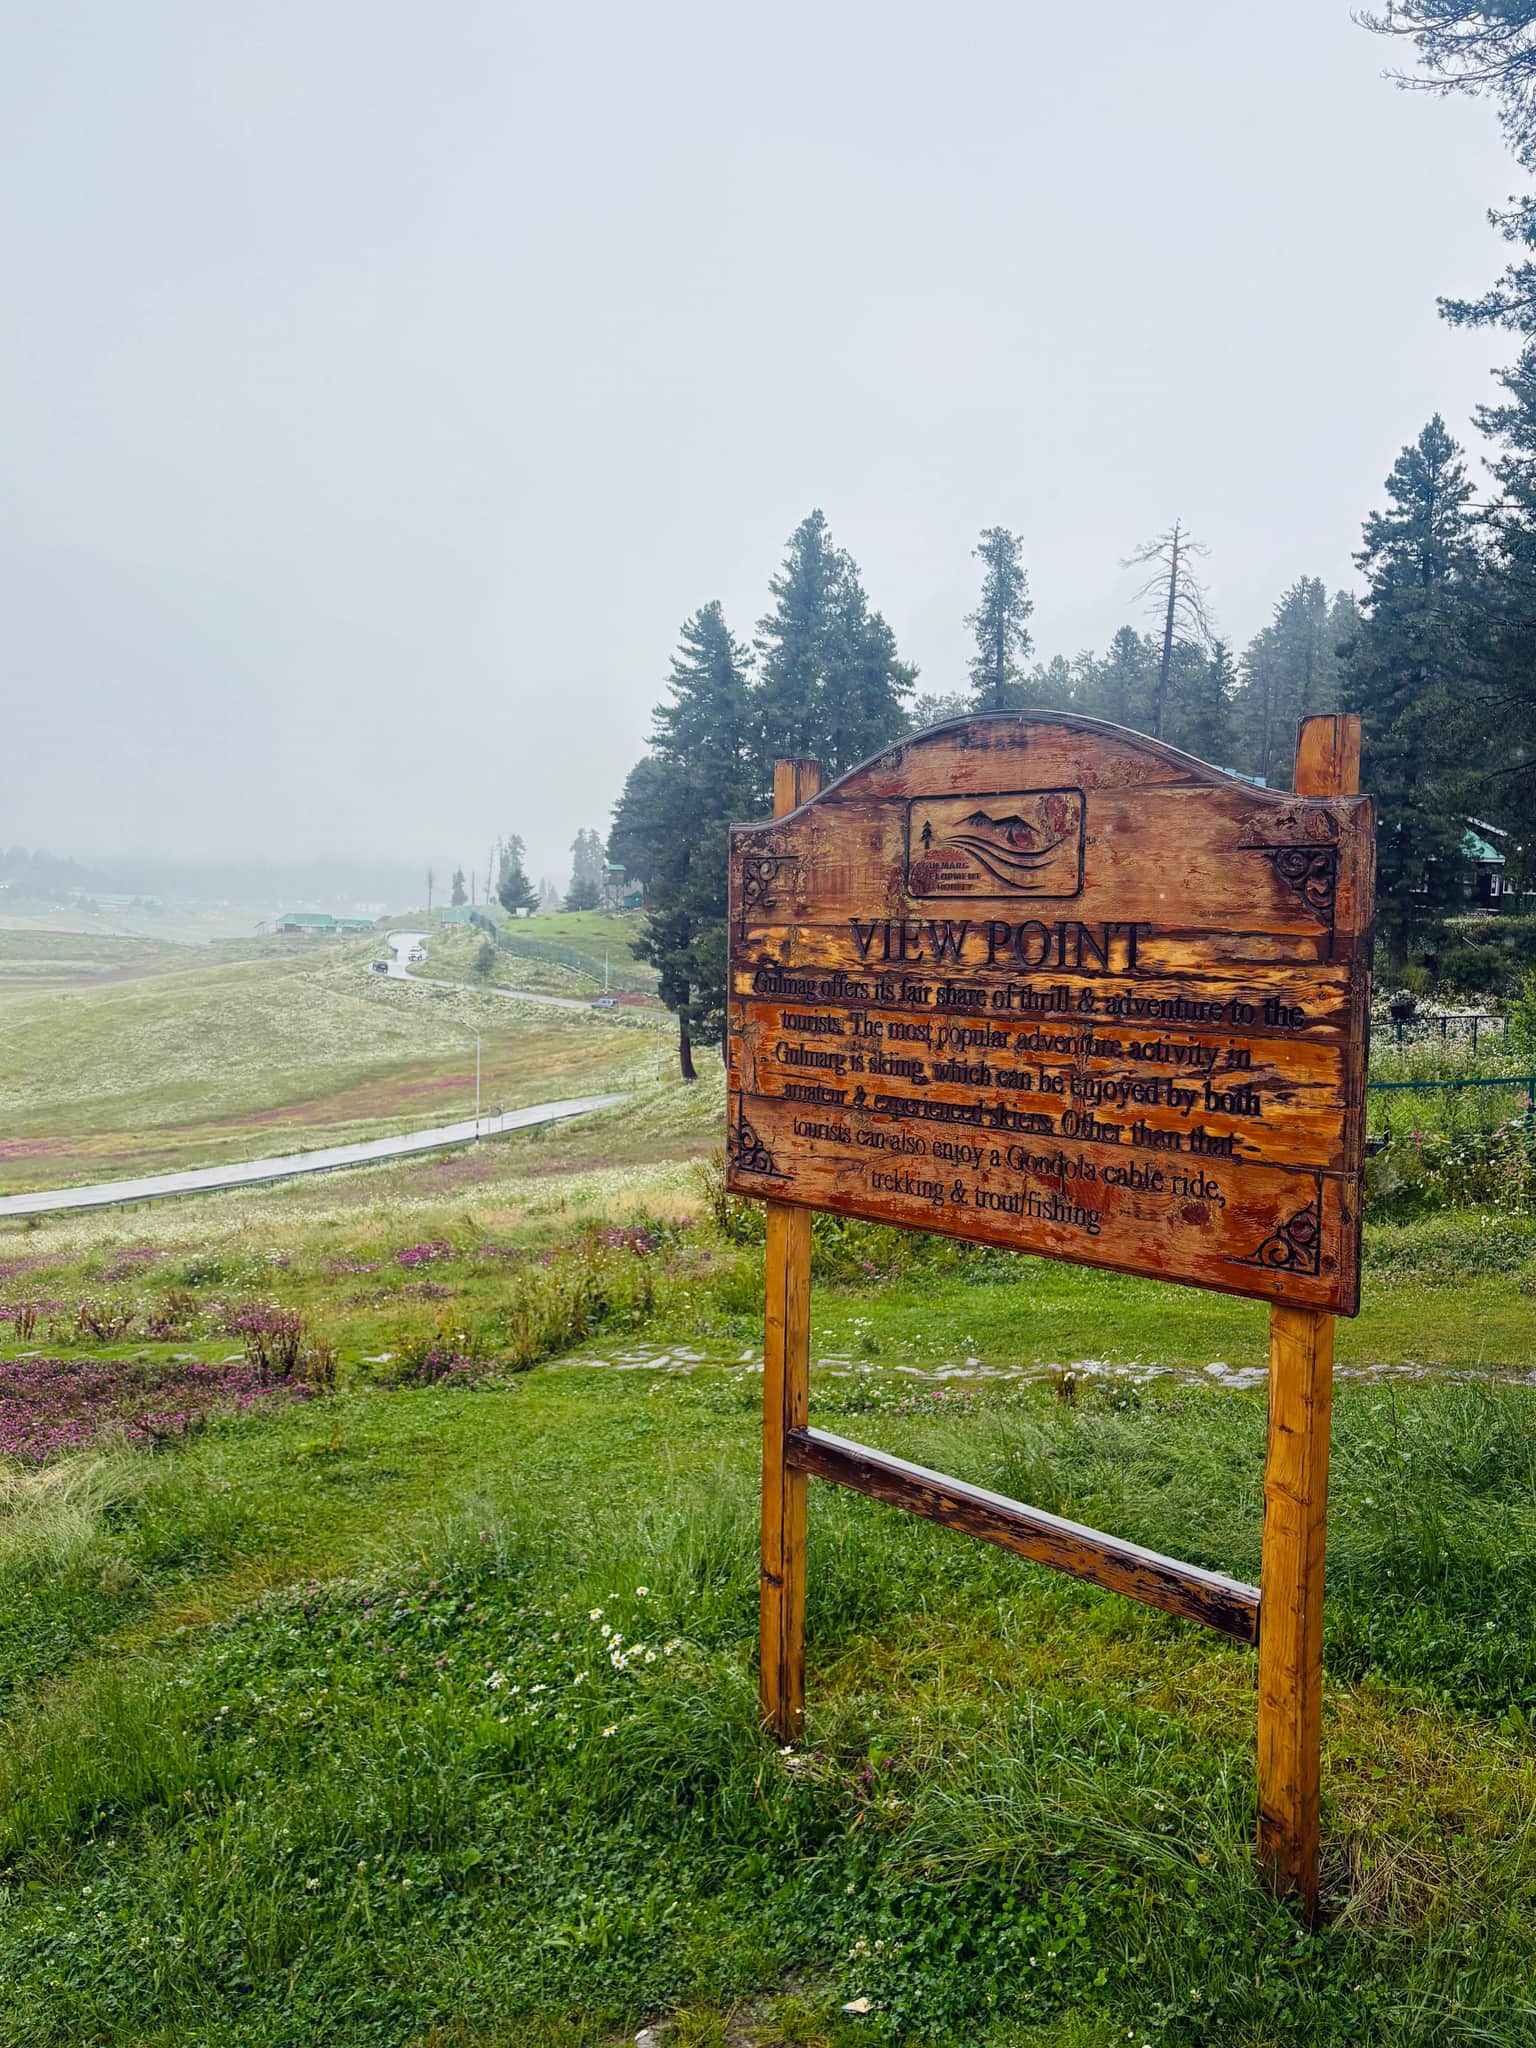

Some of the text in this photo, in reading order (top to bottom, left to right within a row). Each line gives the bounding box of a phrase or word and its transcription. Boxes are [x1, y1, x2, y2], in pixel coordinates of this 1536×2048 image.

[848, 917, 1152, 972] VIEW POINT
[820, 974, 869, 999] offers
[874, 976, 895, 1002] its
[900, 978, 932, 1005] fair
[936, 979, 988, 1007] share
[992, 983, 1014, 1010] of
[1020, 984, 1070, 1012] thrill
[1078, 987, 1098, 1015] &
[1106, 989, 1223, 1025] adventure
[1229, 996, 1256, 1026] to
[1264, 996, 1306, 1031] the
[849, 1012, 884, 1037] The
[888, 1021, 931, 1049] most
[937, 1022, 1011, 1051] popular
[1016, 1026, 1122, 1058] adventure
[1129, 1034, 1220, 1074] activity
[1227, 1039, 1252, 1069] in
[775, 1041, 847, 1076] Gulmarg
[850, 1052, 864, 1073] is
[932, 1058, 993, 1087] which
[997, 1067, 1031, 1092] can
[1039, 1067, 1064, 1096] be
[1070, 1075, 1160, 1110] enjoyed
[1166, 1078, 1199, 1117] by
[1202, 1080, 1262, 1117] both
[784, 1082, 848, 1105] amateur
[853, 1084, 869, 1111] &
[874, 1092, 985, 1124] experienced
[1061, 1109, 1124, 1144] Other
[1131, 1118, 1181, 1151] than
[1190, 1124, 1237, 1158] that
[793, 1116, 1226, 1208] tourists can also enjoy a Gondola cable ride,
[872, 1168, 944, 1207] trekking
[950, 1179, 968, 1205] &
